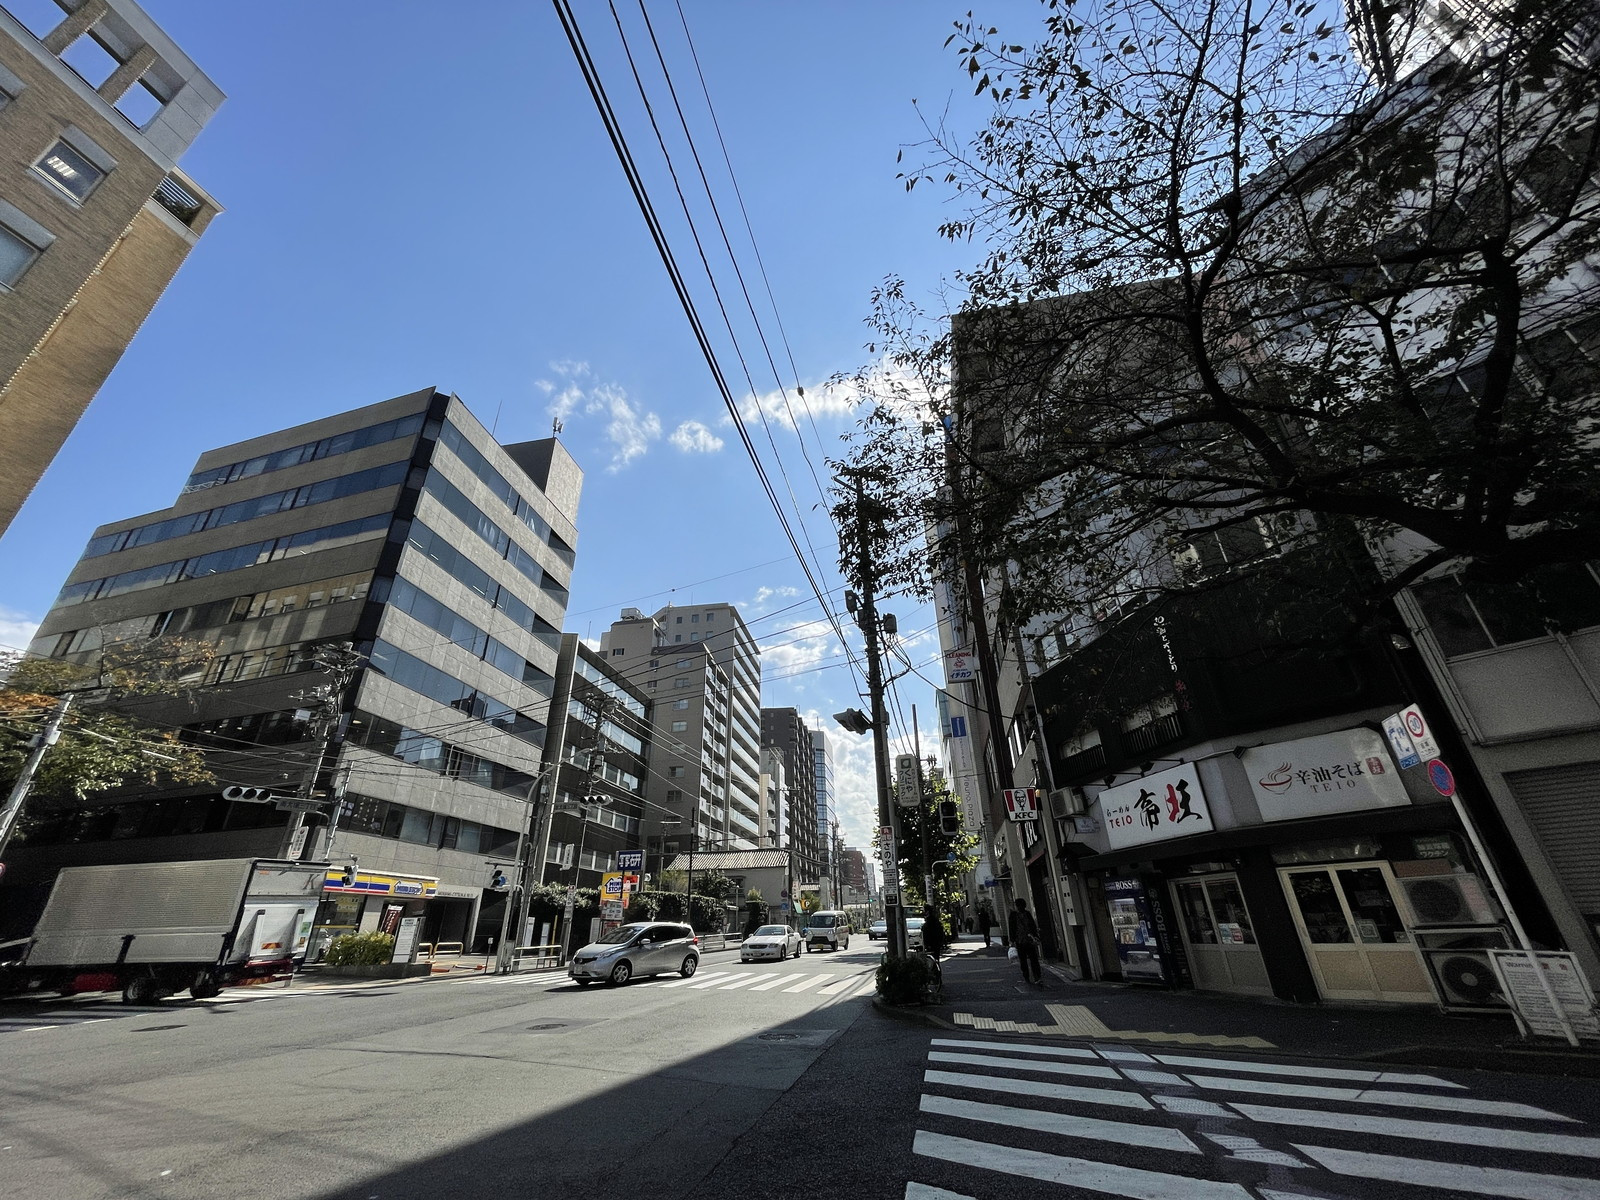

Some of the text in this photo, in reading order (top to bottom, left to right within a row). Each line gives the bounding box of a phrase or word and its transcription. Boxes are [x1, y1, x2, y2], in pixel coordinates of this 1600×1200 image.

[951, 671, 972, 679] イチカワ
[1410, 717, 1420, 731] 30
[1296, 761, 1366, 785] 辛油そば
[905, 769, 914, 793] くにや
[1309, 779, 1357, 794] TEIO
[1014, 811, 1034, 820] KFC
[1106, 805, 1130, 817] らーめん
[1109, 815, 1133, 829] TEIO
[884, 842, 892, 869] さのや
[1115, 880, 1133, 890] BOSS
[1152, 901, 1166, 931] BOSS
